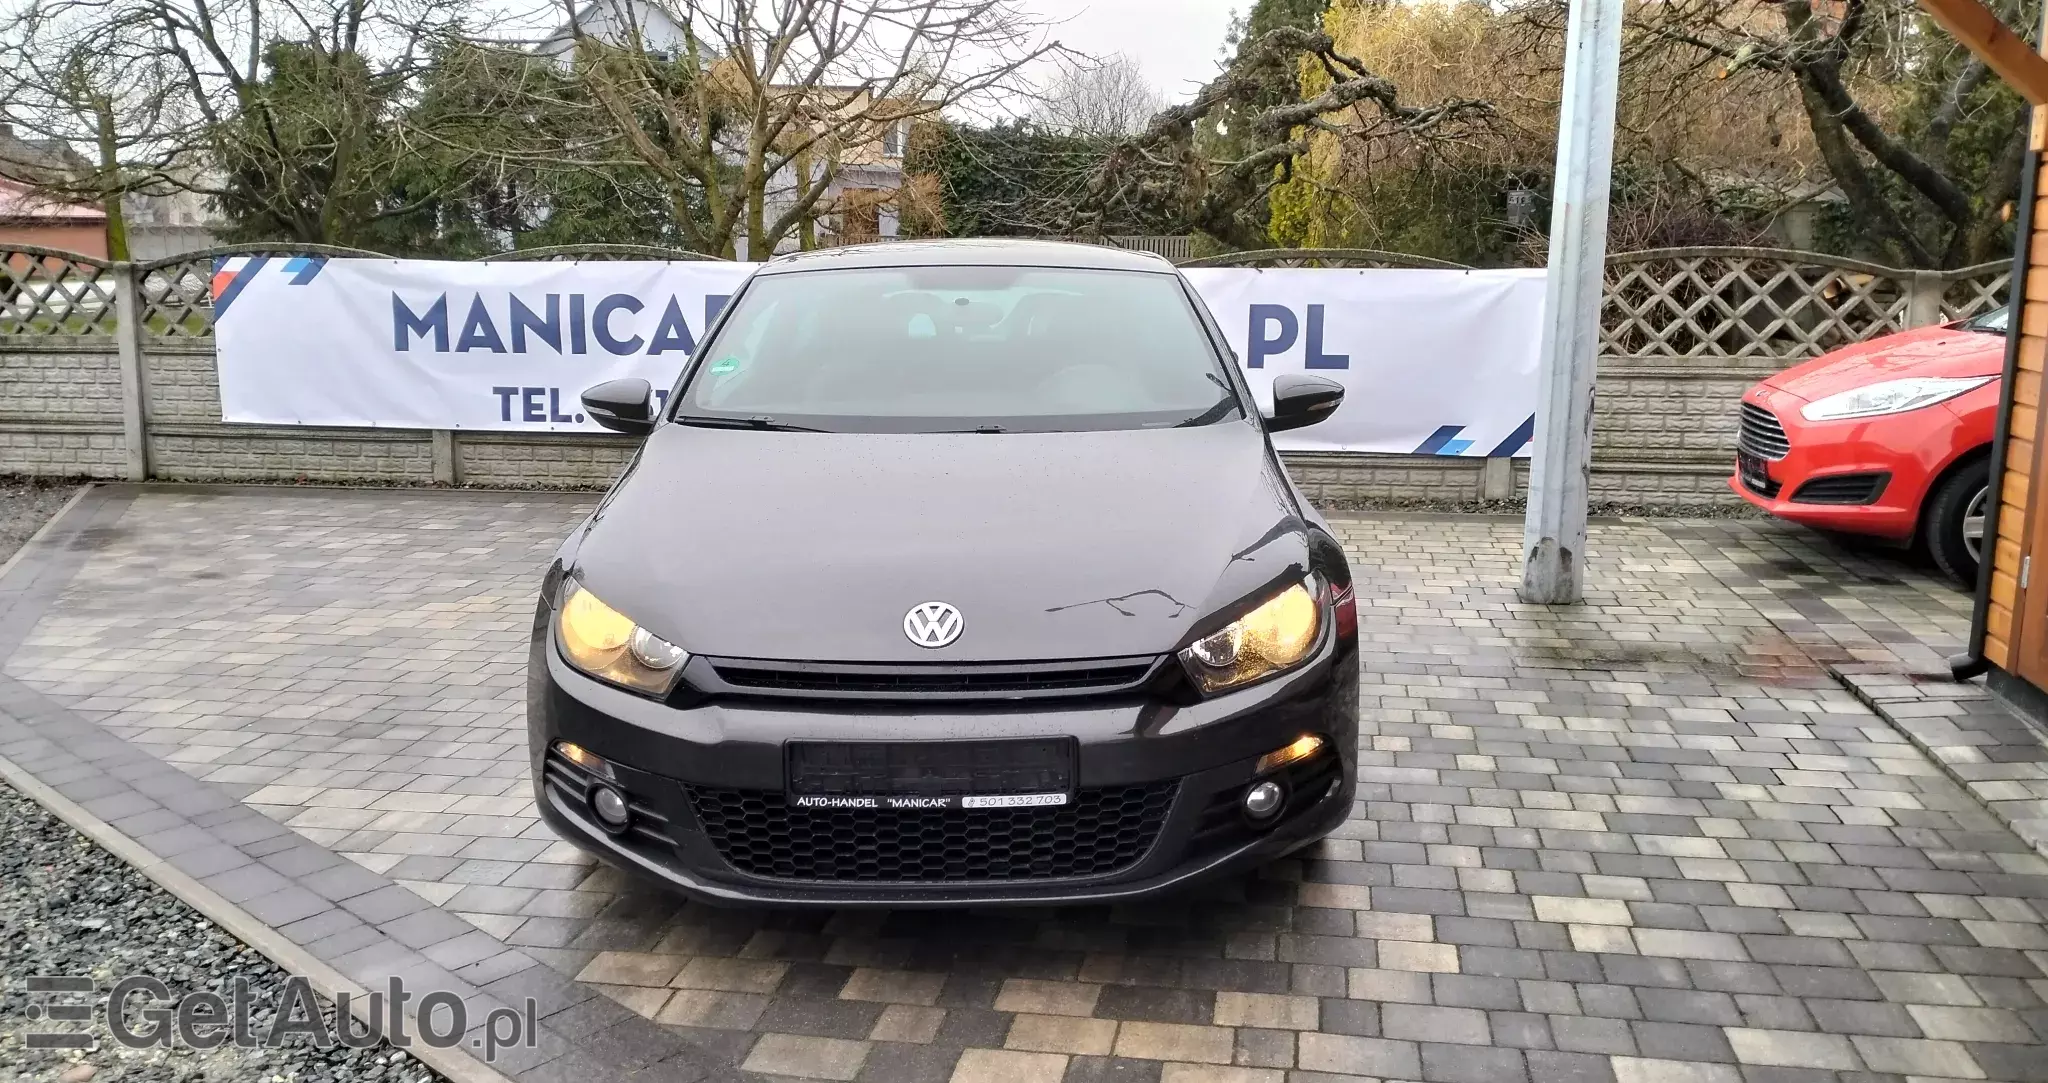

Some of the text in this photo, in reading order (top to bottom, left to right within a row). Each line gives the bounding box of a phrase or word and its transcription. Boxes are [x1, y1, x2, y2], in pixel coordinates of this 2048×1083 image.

[493, 386, 585, 424] TEL.
[797, 795, 1061, 808] AUTO-HANDEL "MANICAR" 501 332 703
